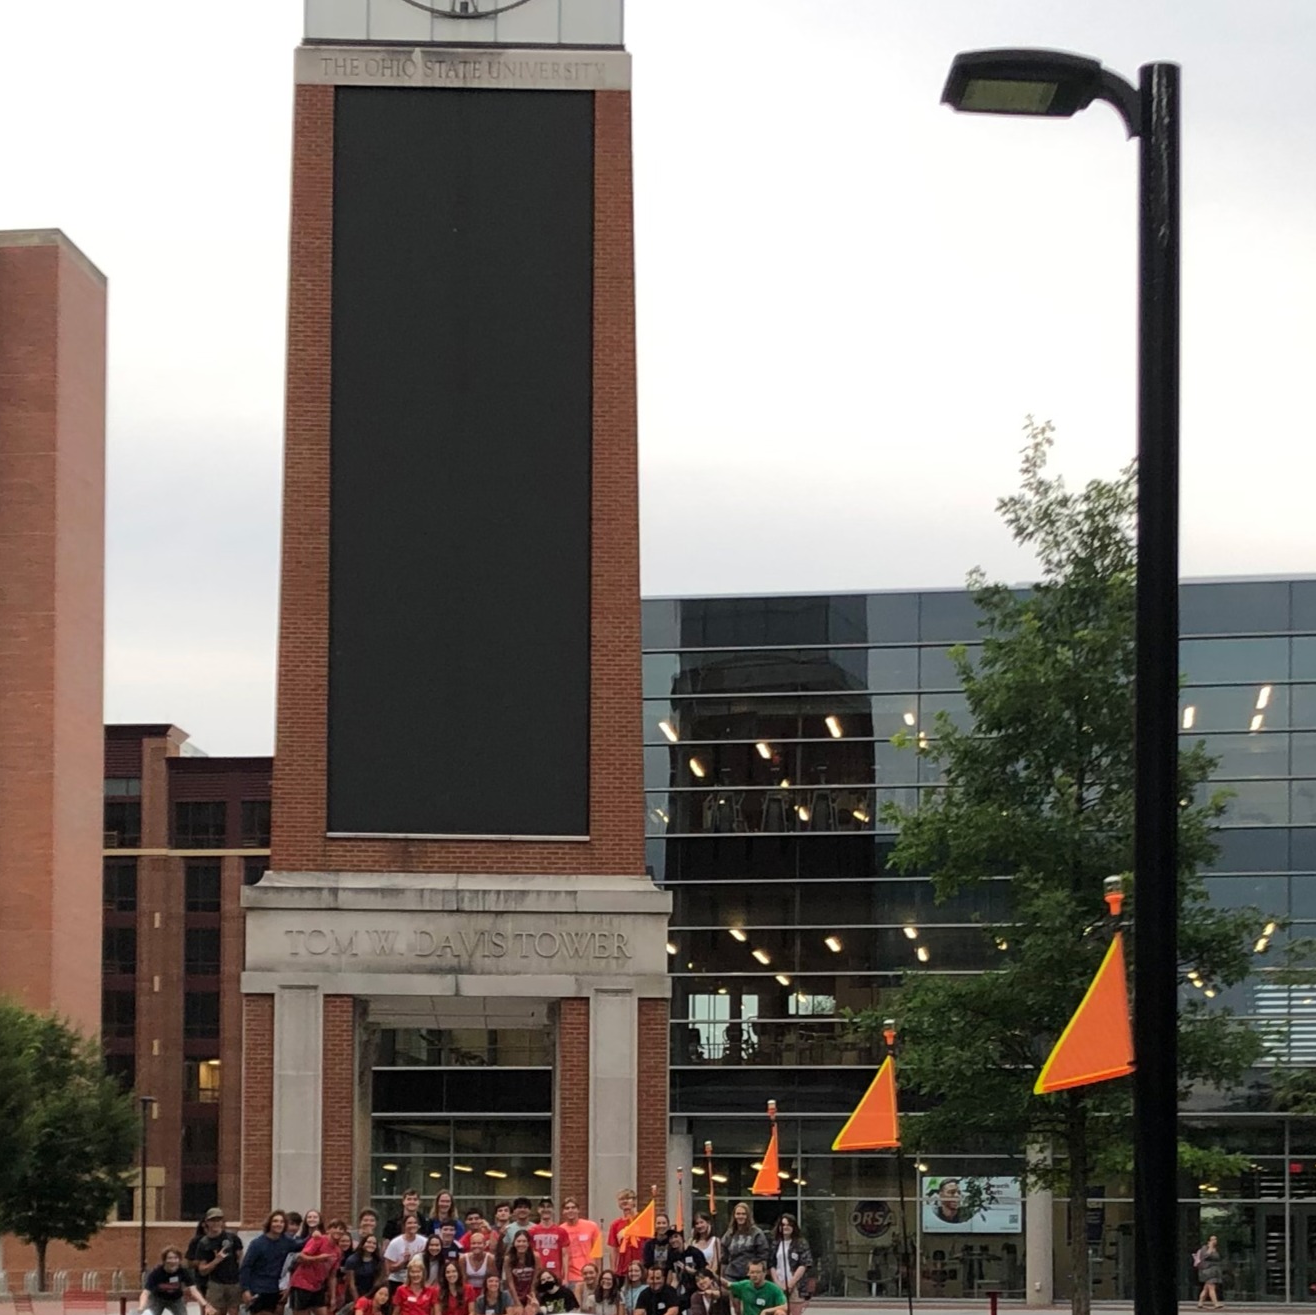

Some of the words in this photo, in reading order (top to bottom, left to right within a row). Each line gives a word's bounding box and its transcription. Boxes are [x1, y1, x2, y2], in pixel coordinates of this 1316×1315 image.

[320, 57, 360, 77] THE
[364, 58, 417, 78] OHIO
[424, 59, 483, 79] STATE
[486, 60, 606, 81] UNIVERSITY
[285, 929, 359, 956] TOM
[365, 929, 405, 957] W.
[413, 930, 507, 958] DAVIS
[514, 931, 633, 960] TOWER
